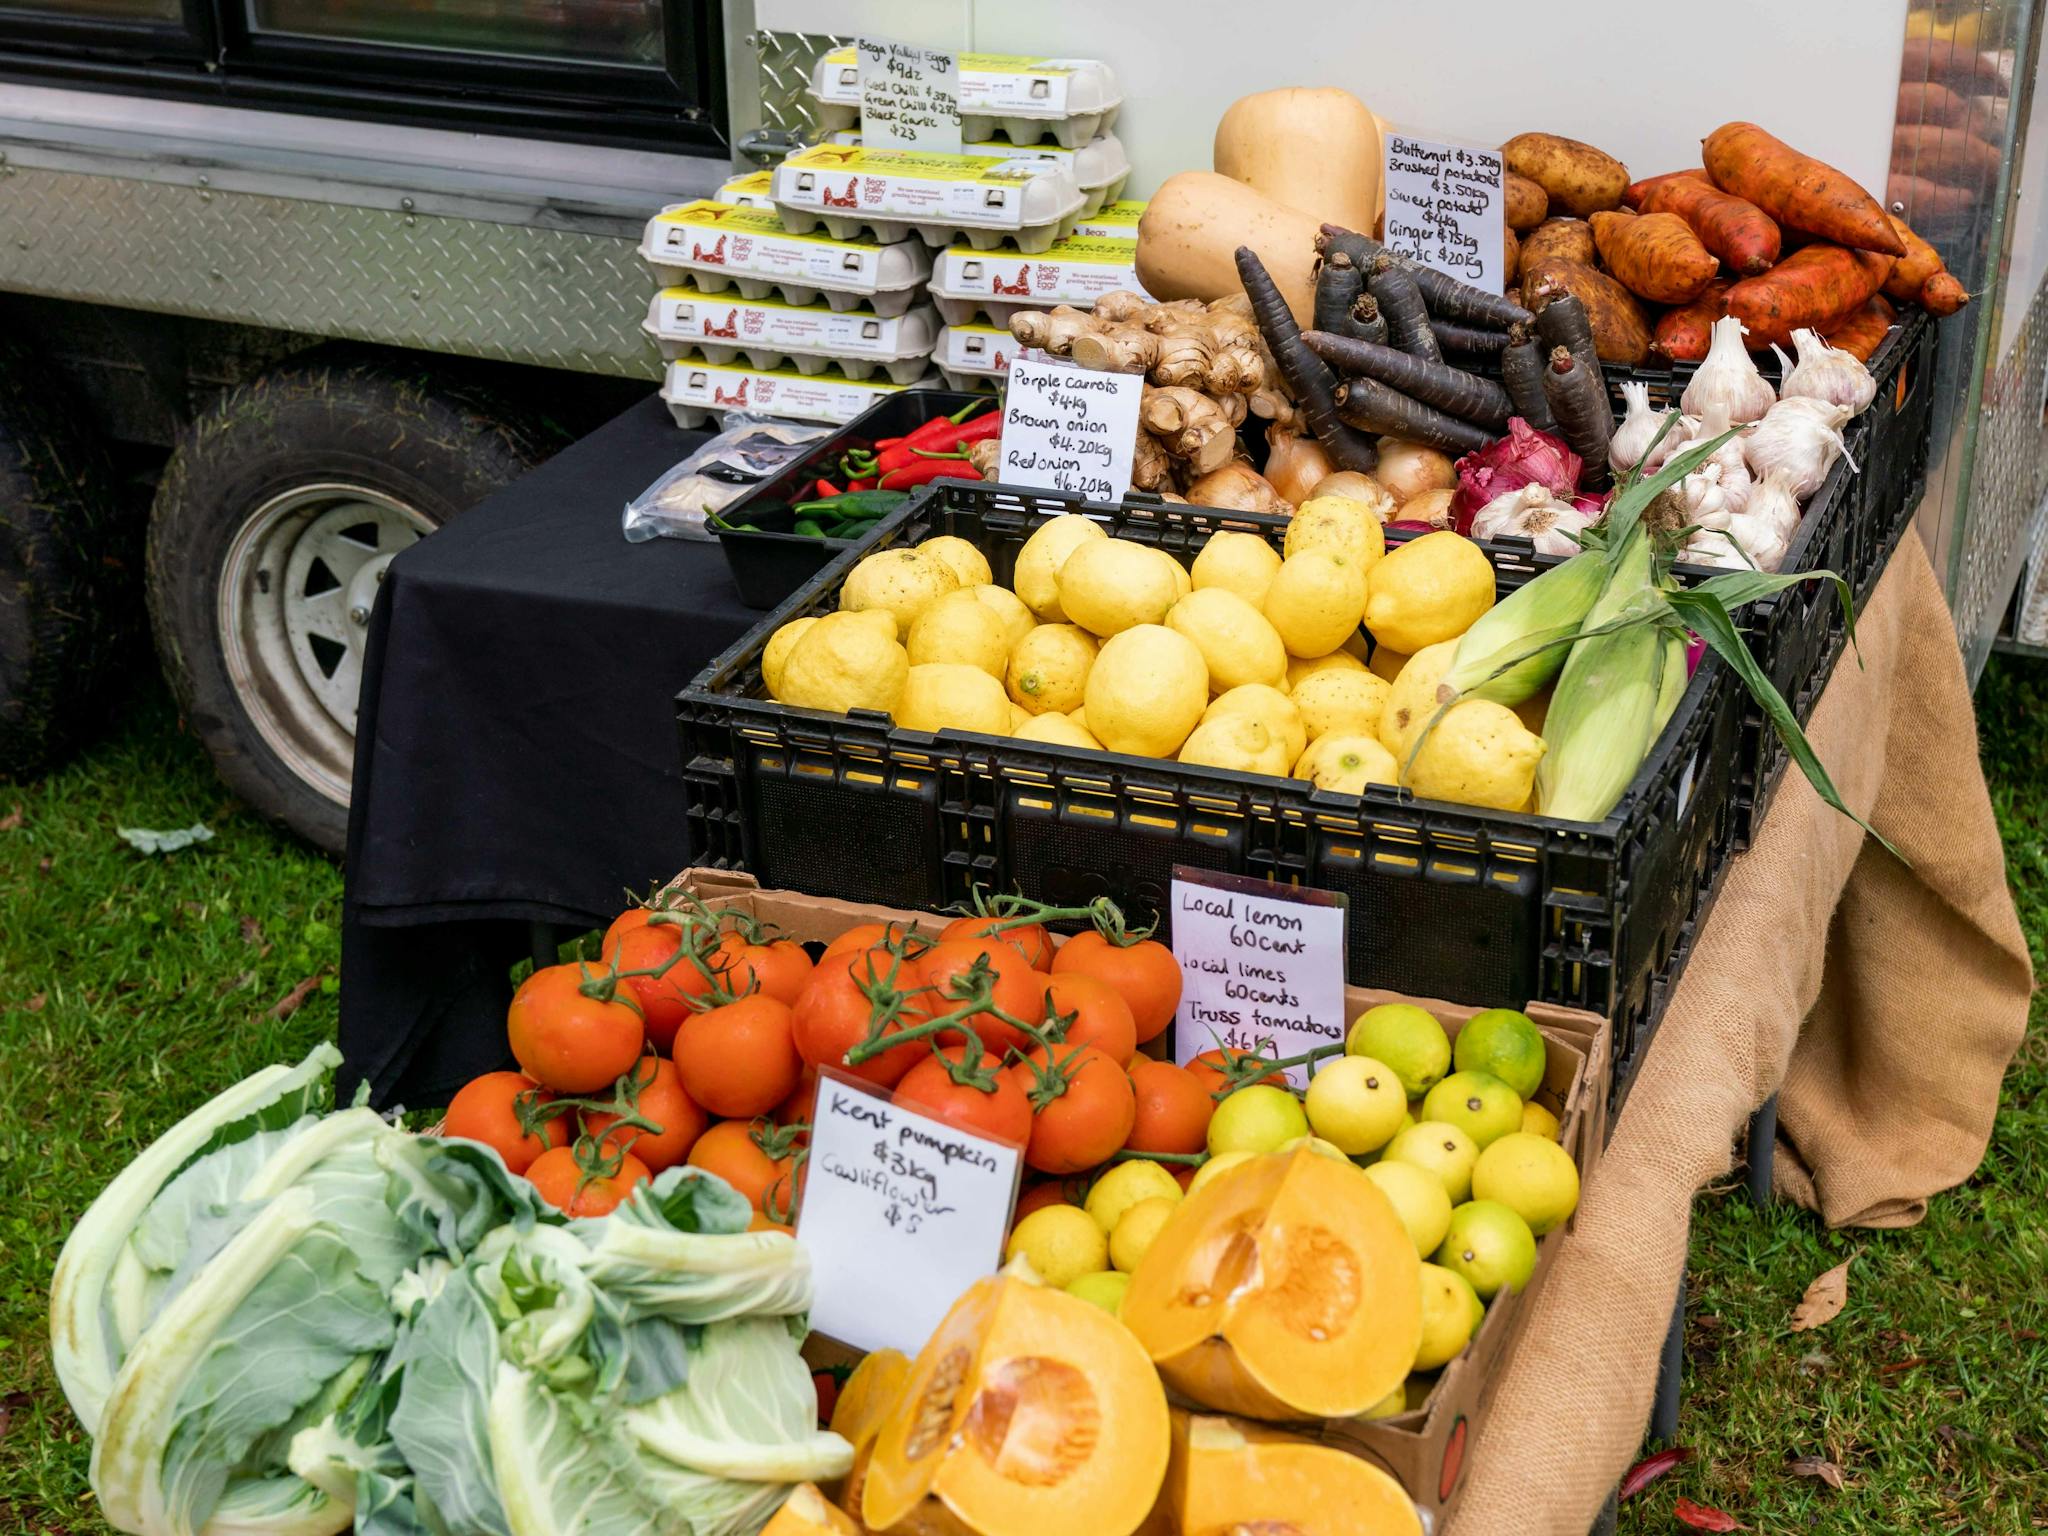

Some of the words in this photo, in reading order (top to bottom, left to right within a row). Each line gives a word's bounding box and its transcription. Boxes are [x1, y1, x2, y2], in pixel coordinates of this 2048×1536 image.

[858, 39, 886, 62] Bega
[924, 51, 951, 73] Eggs
[864, 92, 896, 107] Green
[866, 107, 897, 120] Black
[900, 113, 938, 127] Garlic
[890, 123, 917, 141] $23
[1391, 137, 1451, 163] Butternut
[866, 177, 886, 188] Bega
[1389, 158, 1440, 177] Brushed
[1444, 168, 1500, 189] potatoes
[864, 185, 886, 196] Valley
[865, 193, 882, 204] Eggs
[1389, 188, 1433, 209] Sweet
[1437, 198, 1483, 217] potato
[1389, 219, 1434, 249] Ginger
[1036, 272, 1060, 282] Valley
[1039, 263, 1060, 274] Bega
[1037, 280, 1056, 290] Eggs
[1014, 368, 1061, 394] Purple
[1008, 408, 1060, 429] Brown
[1067, 420, 1108, 433] onion
[1008, 450, 1037, 469] Red
[1038, 457, 1081, 471] onion
[1183, 893, 1235, 919] Local
[1245, 905, 1303, 932] lemon
[1239, 961, 1287, 983] limes
[1185, 1000, 1241, 1026] Truss
[1252, 1008, 1342, 1039] tomatoes
[830, 1092, 893, 1130] Kent
[899, 1126, 997, 1175] pumpkin
